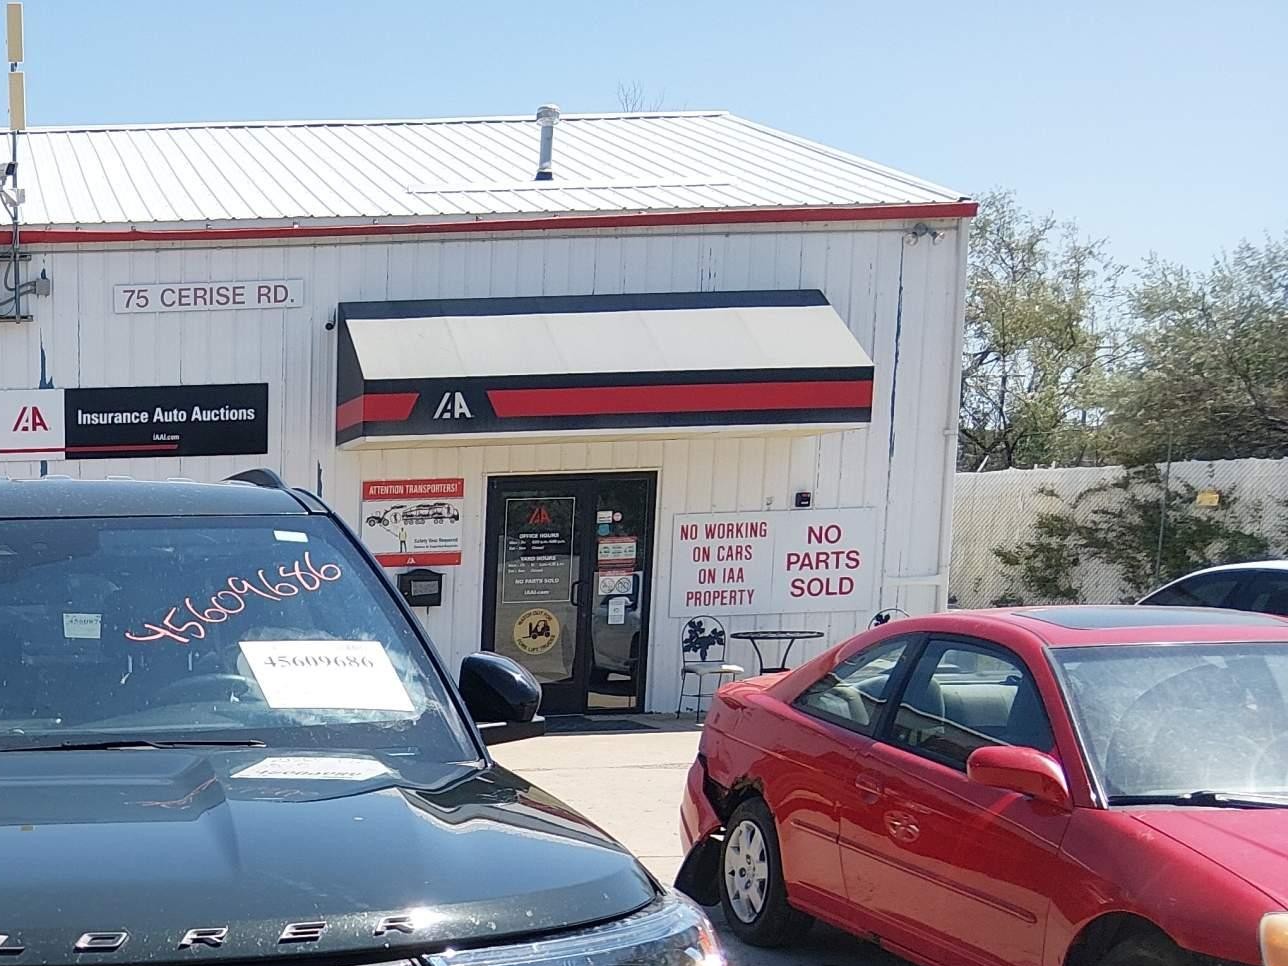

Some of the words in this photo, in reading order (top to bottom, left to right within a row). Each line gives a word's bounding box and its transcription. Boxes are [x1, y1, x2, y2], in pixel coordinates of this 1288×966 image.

[123, 289, 149, 309] 75
[160, 286, 246, 307] CERISE
[257, 284, 295, 305] RD.
[77, 409, 149, 425] Insurance
[153, 407, 187, 422] Auto
[191, 405, 255, 421] Auctions
[369, 485, 404, 495] ATTENTION
[406, 483, 458, 494] TRANSPORTERS!
[680, 524, 698, 540] NO
[705, 521, 767, 539] WORKING
[808, 525, 842, 544] NO
[693, 546, 710, 562] ON
[717, 545, 752, 561] CARS
[786, 550, 860, 571] PARTS
[698, 568, 716, 584] ON
[723, 567, 745, 584] IAA
[790, 576, 854, 598] SOLD
[125, 551, 342, 643] 45609686
[686, 589, 755, 607] PROPERTY
[263, 655, 375, 669] 45609686
